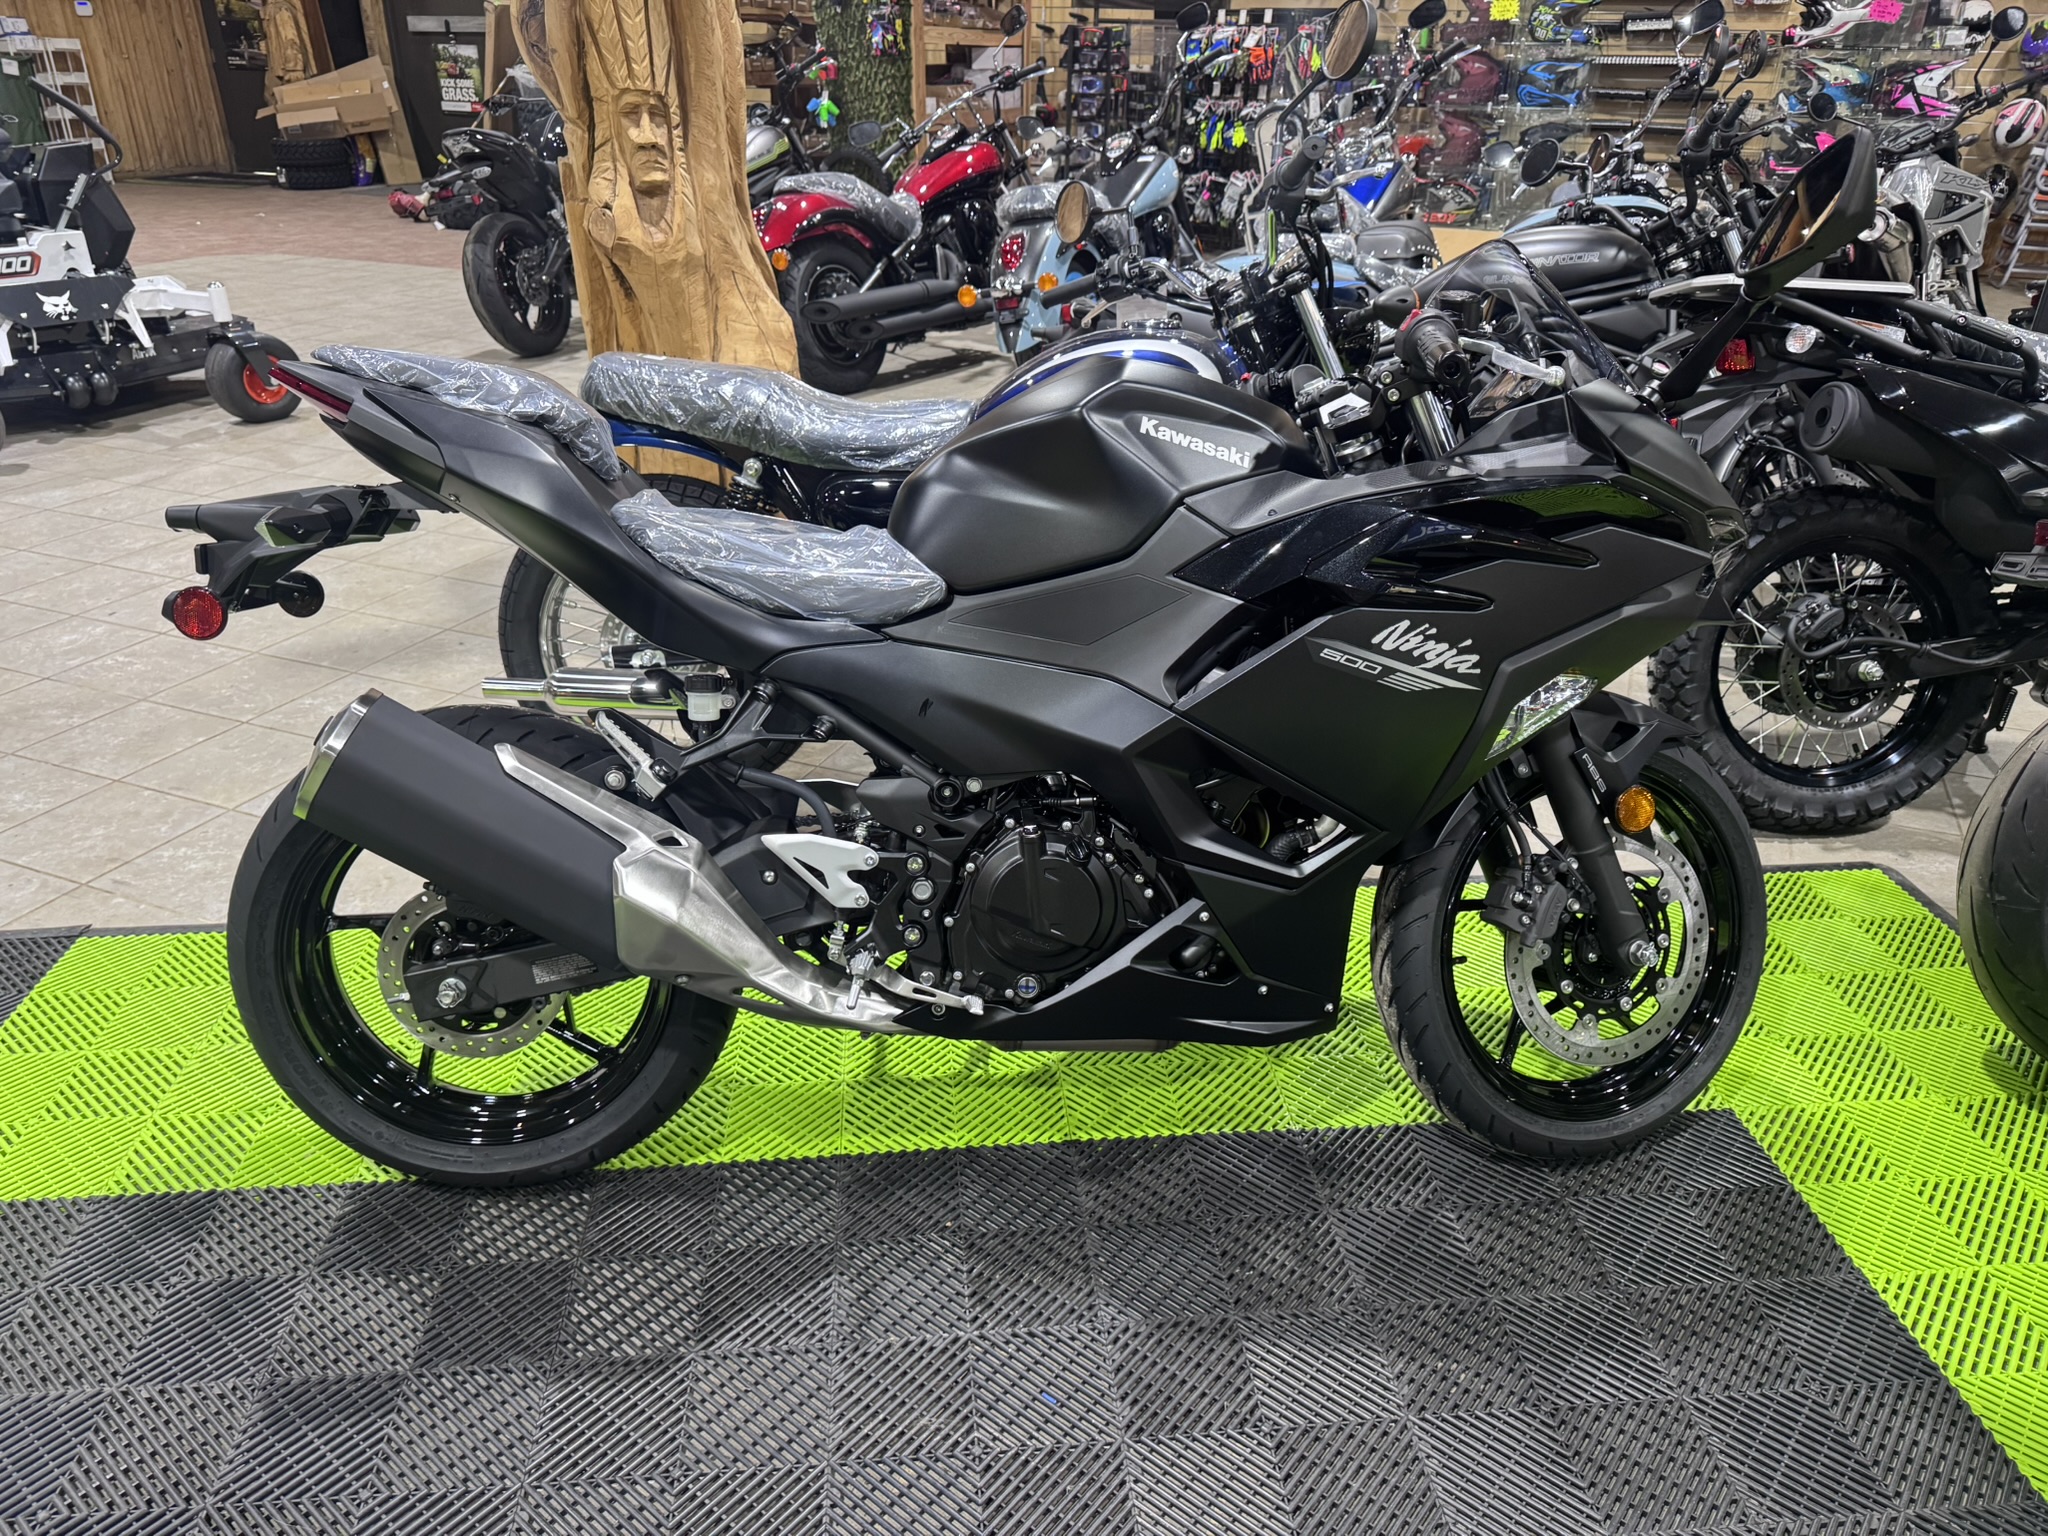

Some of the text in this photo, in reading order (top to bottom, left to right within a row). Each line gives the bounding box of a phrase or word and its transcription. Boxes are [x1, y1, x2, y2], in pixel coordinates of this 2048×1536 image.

[440, 78, 475, 88] KICK SOME
[441, 87, 479, 102] GRASS.
[0, 255, 32, 273] 00
[1139, 415, 1251, 469] Kawasaki
[1371, 619, 1481, 674] Ninja
[1319, 647, 1383, 675] 500
[1582, 753, 1607, 793] ABS
